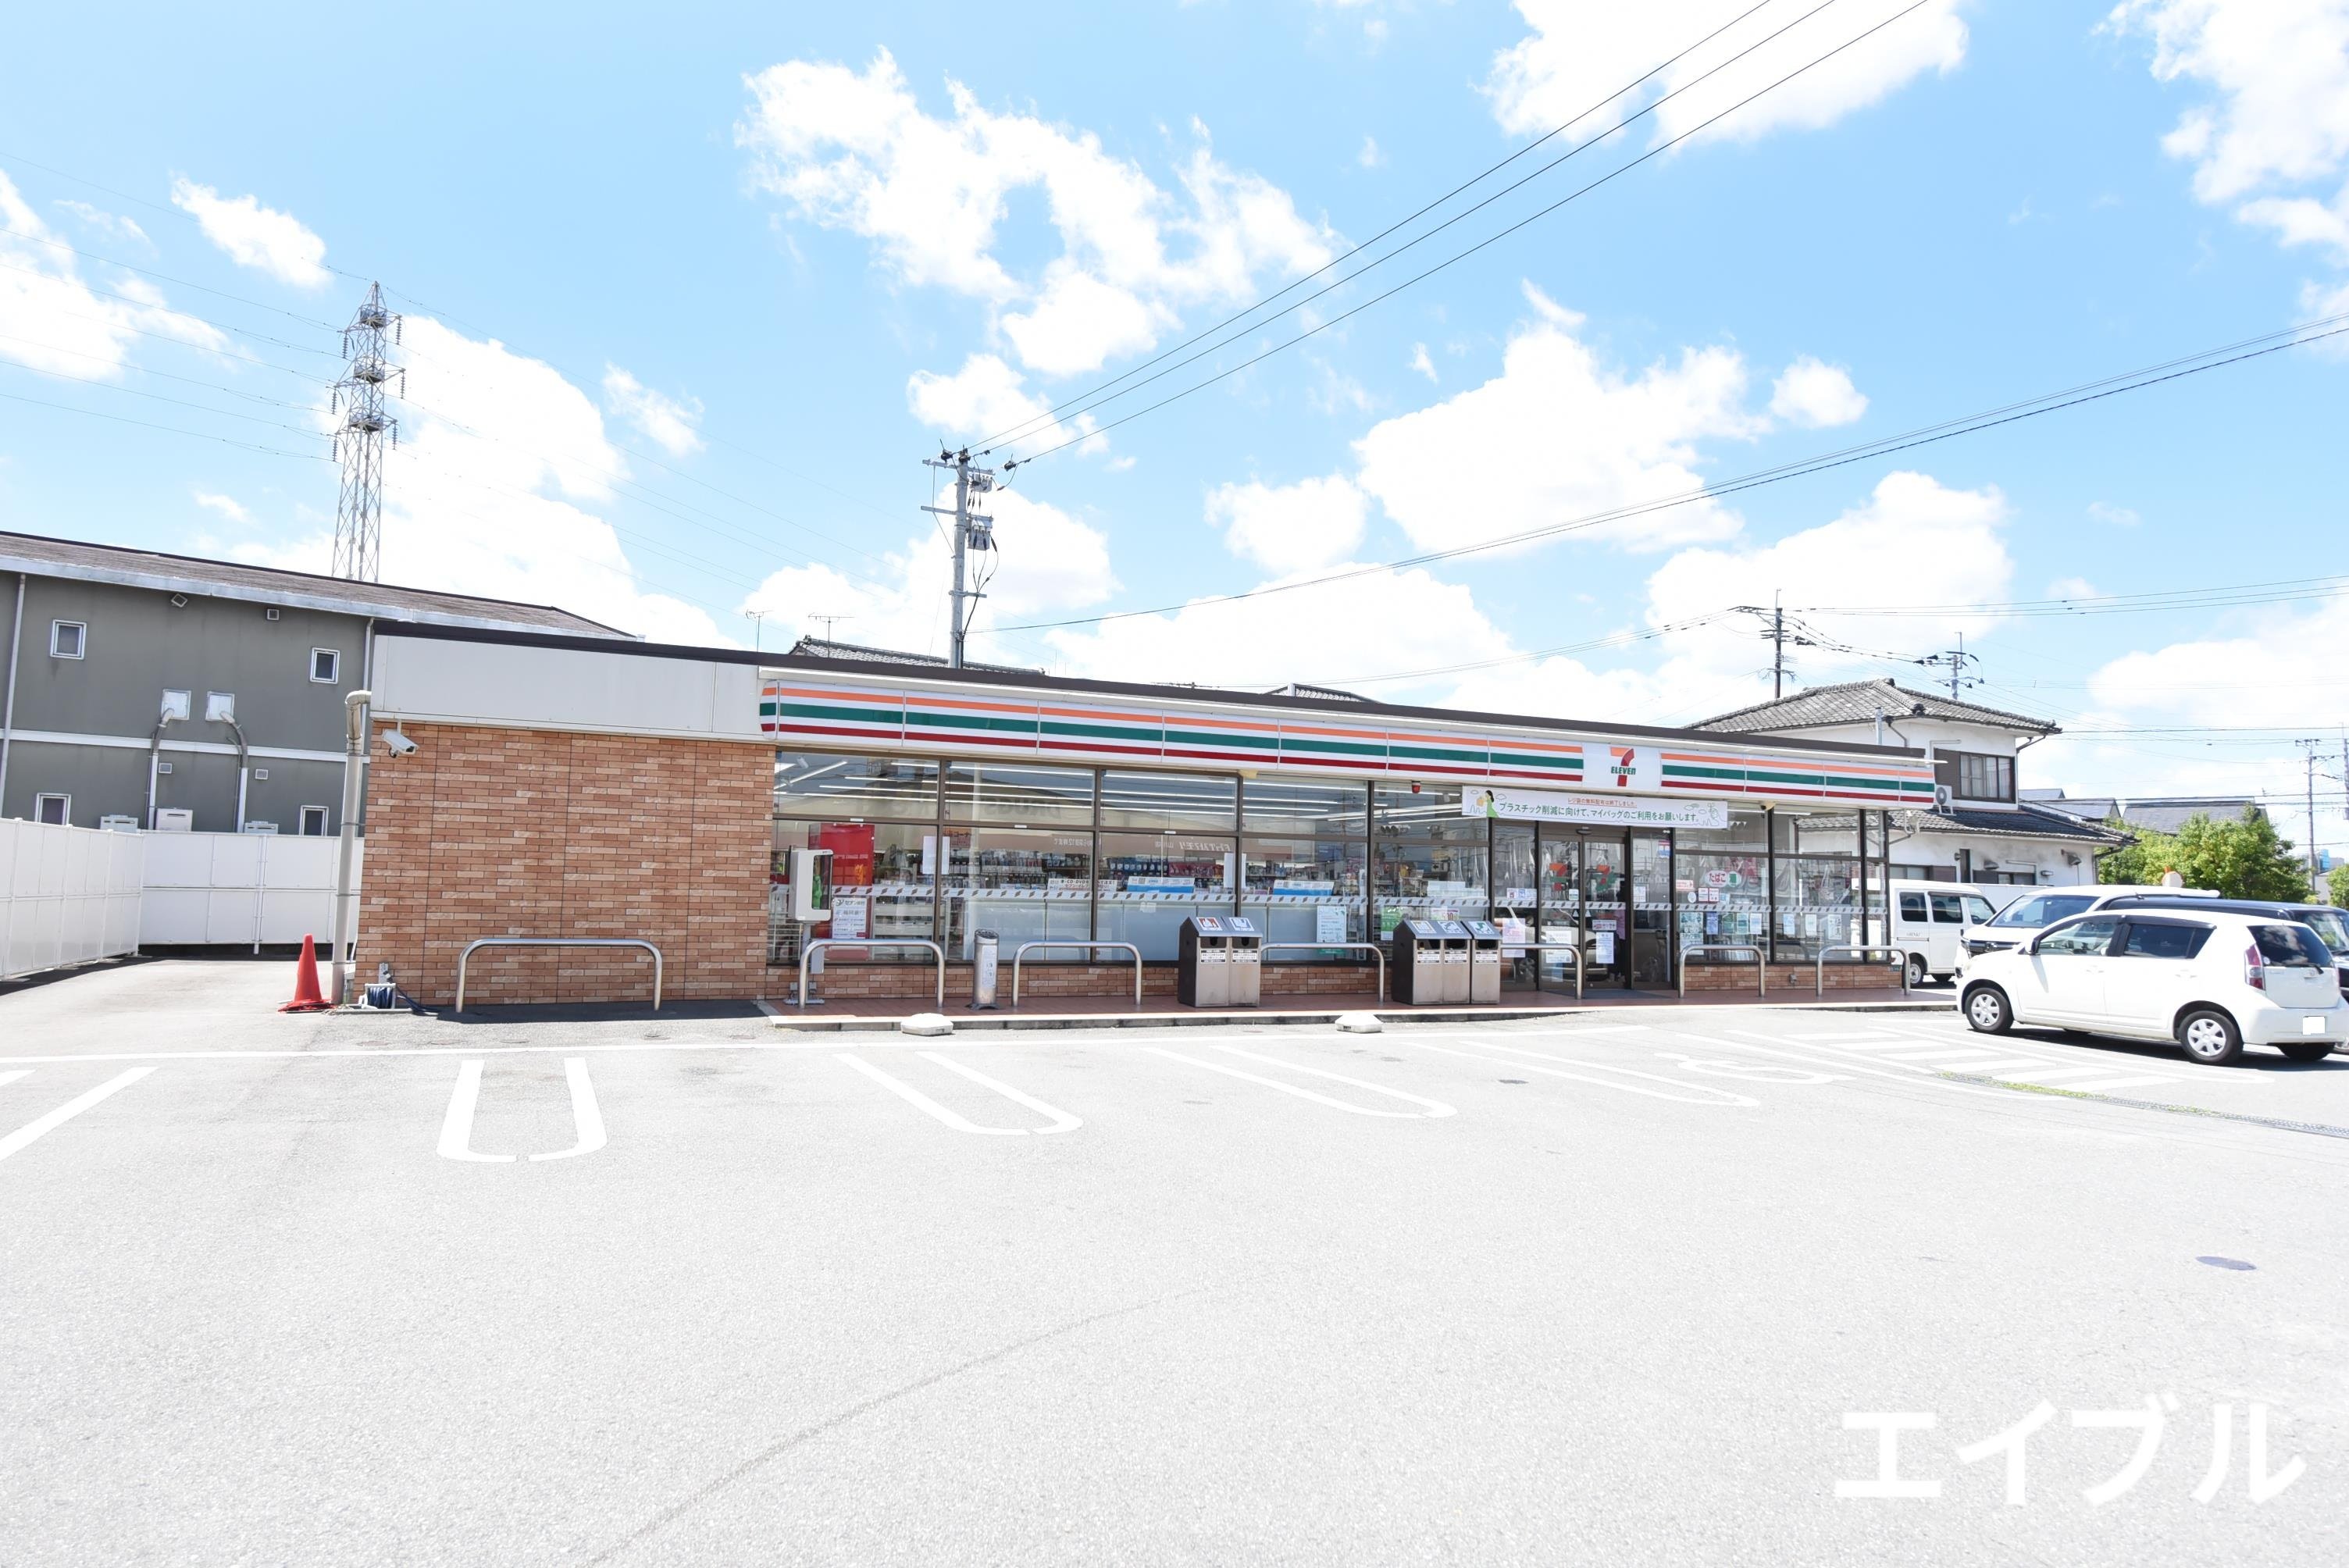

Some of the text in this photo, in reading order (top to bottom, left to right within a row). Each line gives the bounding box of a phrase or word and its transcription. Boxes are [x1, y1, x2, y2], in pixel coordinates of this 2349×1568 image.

[1610, 747, 1634, 787] 7
[1709, 873, 1726, 882] たばこ
